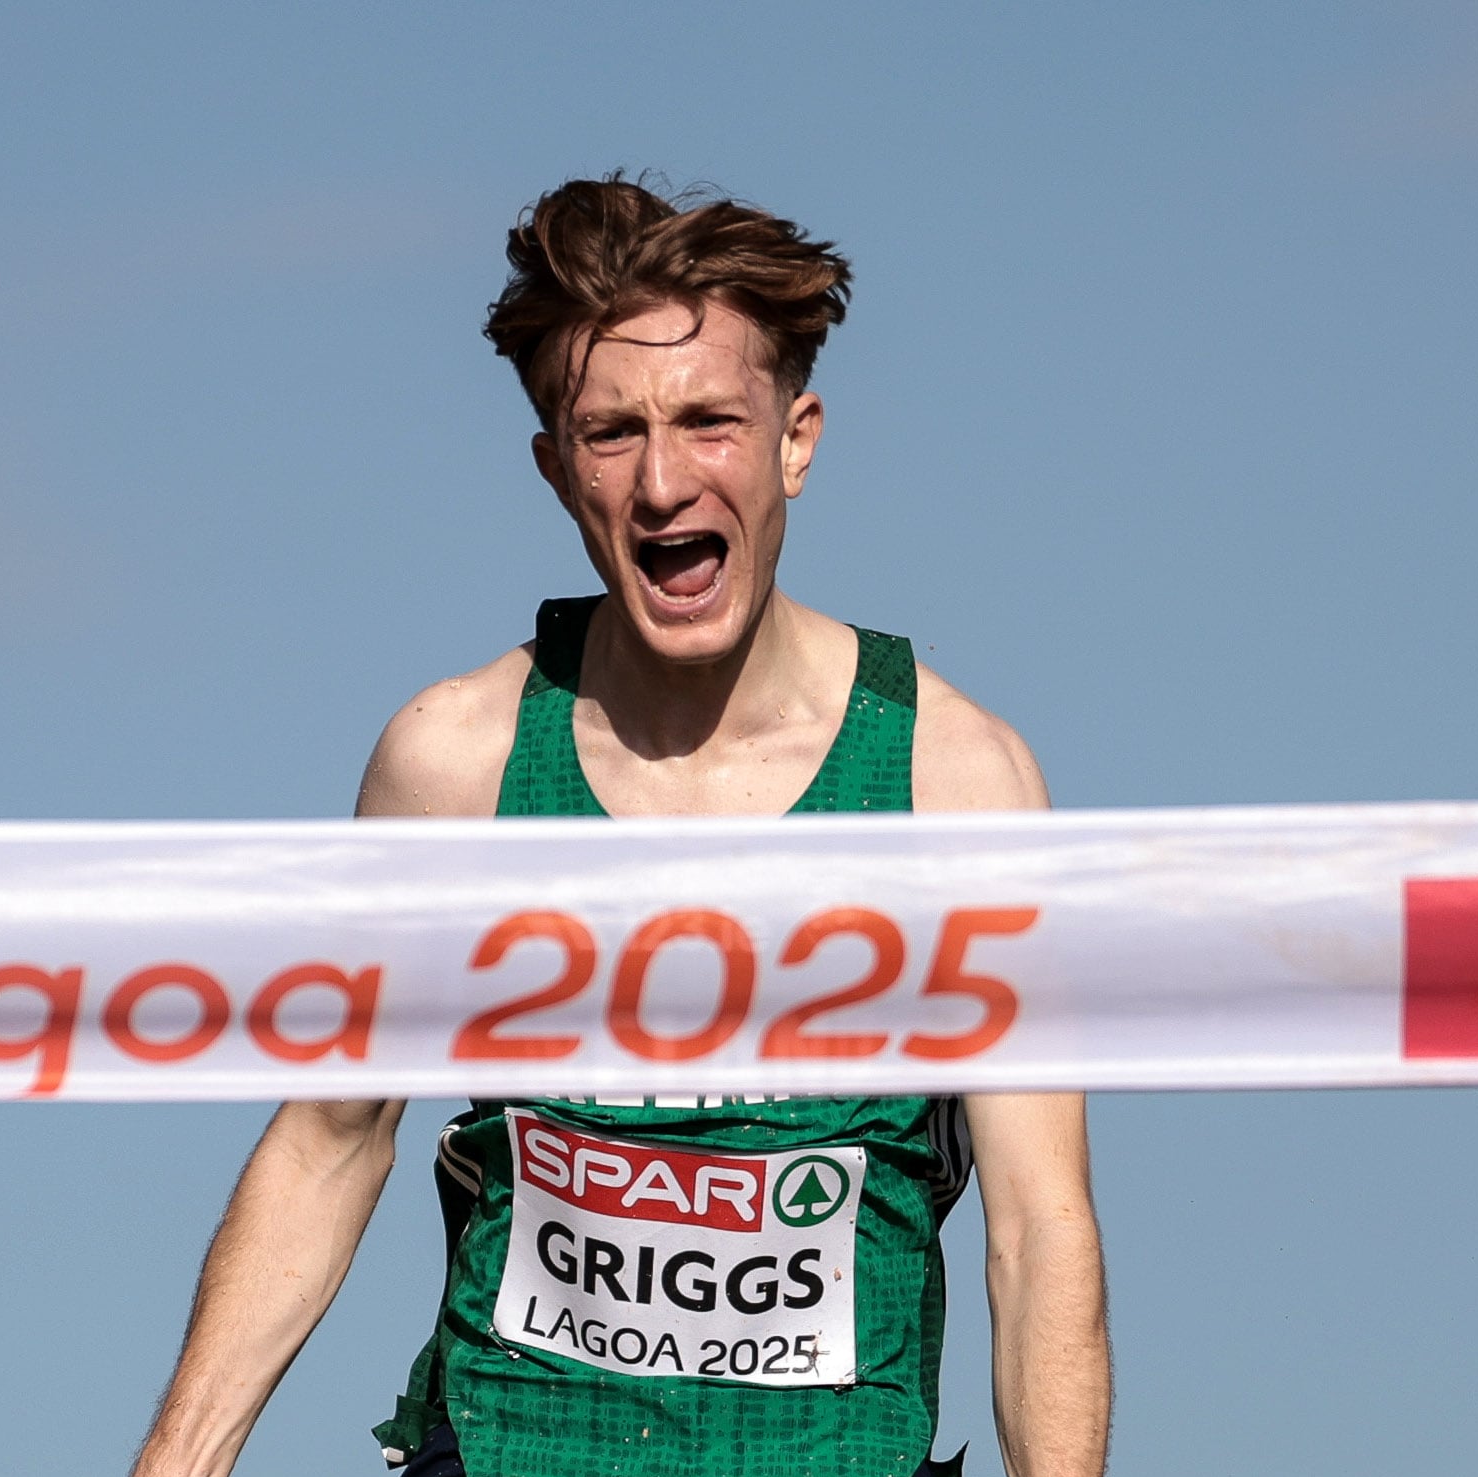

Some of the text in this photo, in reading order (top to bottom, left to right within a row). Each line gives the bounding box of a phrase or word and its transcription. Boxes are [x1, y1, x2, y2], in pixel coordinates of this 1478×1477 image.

[449, 905, 1040, 1063] 2025
[523, 1128, 759, 1223] SPAR
[536, 1220, 825, 1315] GRIGGS
[523, 1294, 818, 1377] LAGOA 2025
